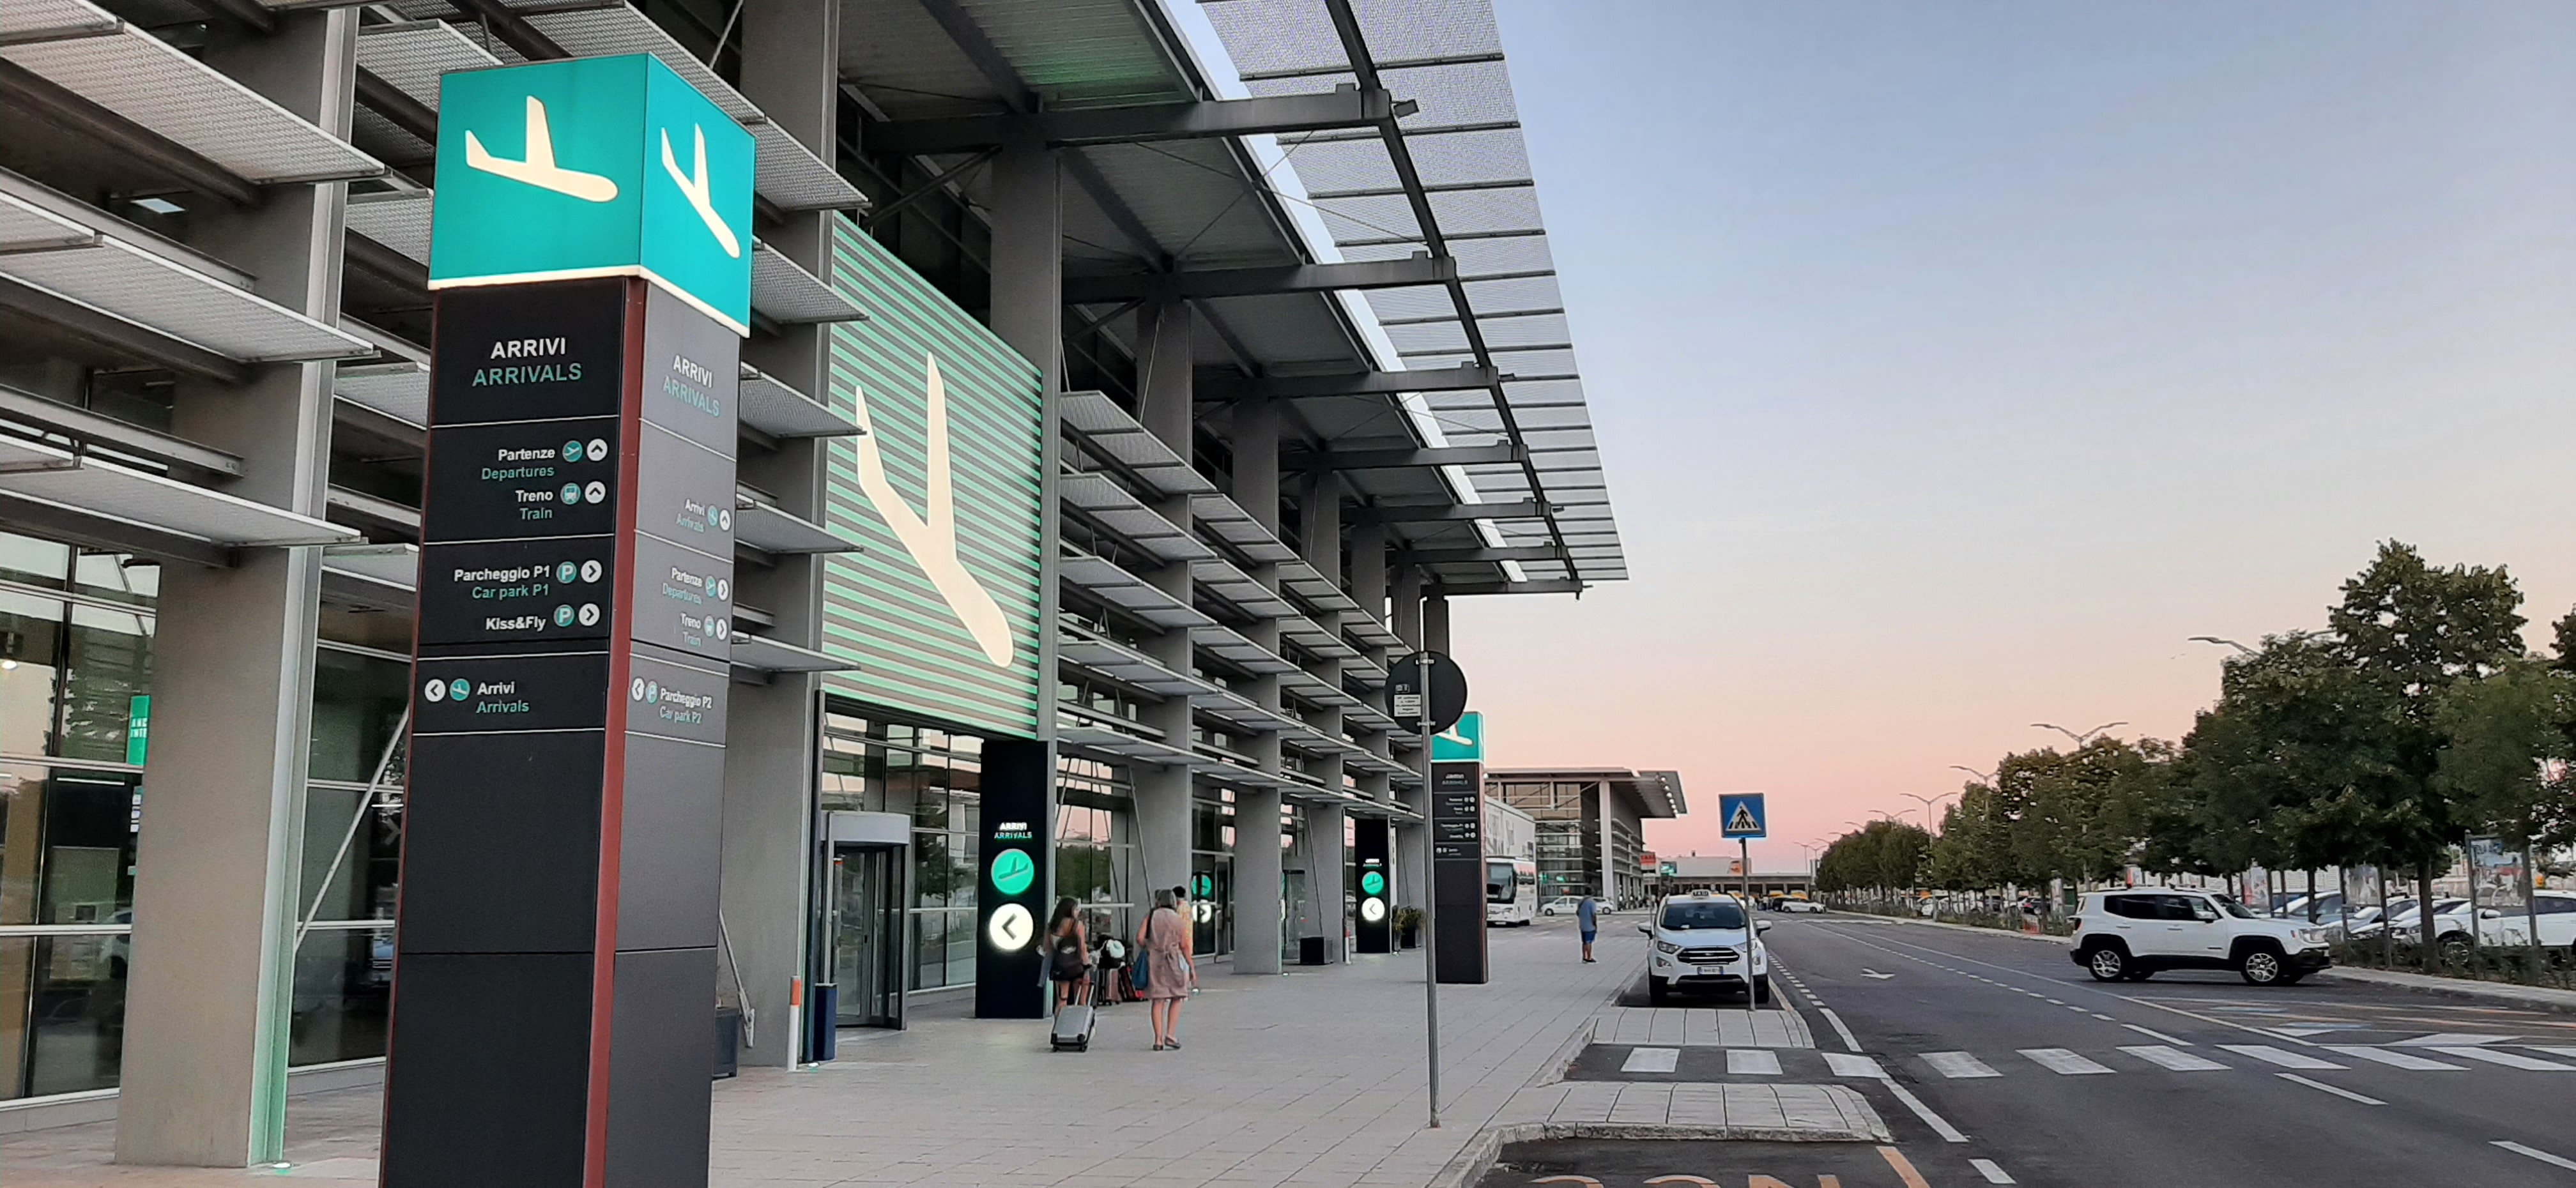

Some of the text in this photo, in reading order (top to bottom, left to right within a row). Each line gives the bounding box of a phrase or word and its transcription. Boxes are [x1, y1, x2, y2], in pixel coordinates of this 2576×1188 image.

[491, 337, 566, 359] ARRIVI
[472, 362, 582, 387] ARRIVALS
[673, 354, 712, 388] ARRIVI
[663, 376, 720, 417] ARRIVALS
[498, 447, 555, 462] Partenze
[482, 466, 555, 482] Departures
[516, 489, 553, 503] Treno
[520, 507, 553, 521] Train
[454, 567, 530, 583] Parcheggio
[533, 565, 550, 579] P1
[472, 584, 549, 601] Car park P1
[486, 616, 546, 632] Kiss&Fly
[680, 613, 702, 629] Treno
[477, 682, 514, 696] Arrivi
[476, 701, 529, 714] Arrivals
